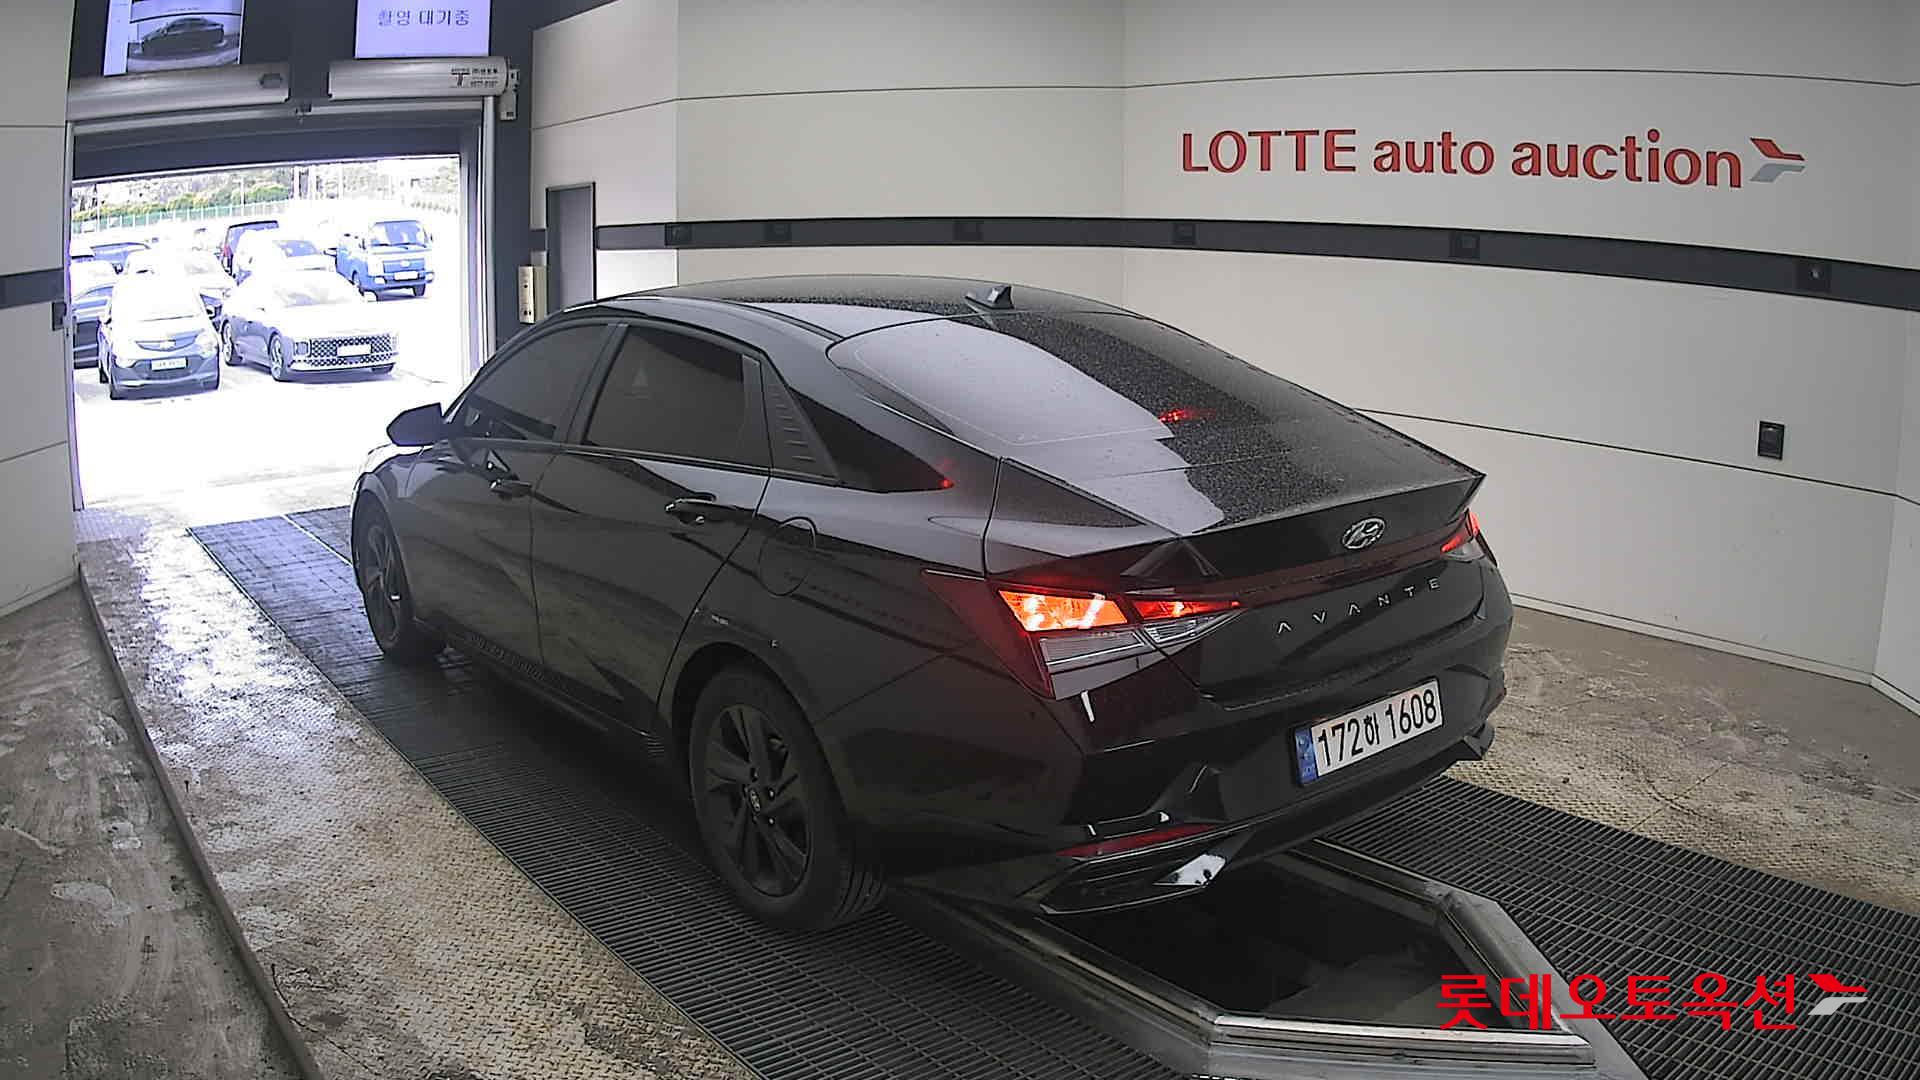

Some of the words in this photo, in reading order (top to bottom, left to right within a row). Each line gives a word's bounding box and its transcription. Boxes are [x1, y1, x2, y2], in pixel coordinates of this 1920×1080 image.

[1182, 129, 1357, 173] LOTTE
[1373, 131, 1495, 175] auto
[1511, 129, 1742, 188] auction
[1277, 577, 1441, 634] AVANTE
[1318, 712, 1380, 767] 172하
[1385, 689, 1437, 740] 1608
